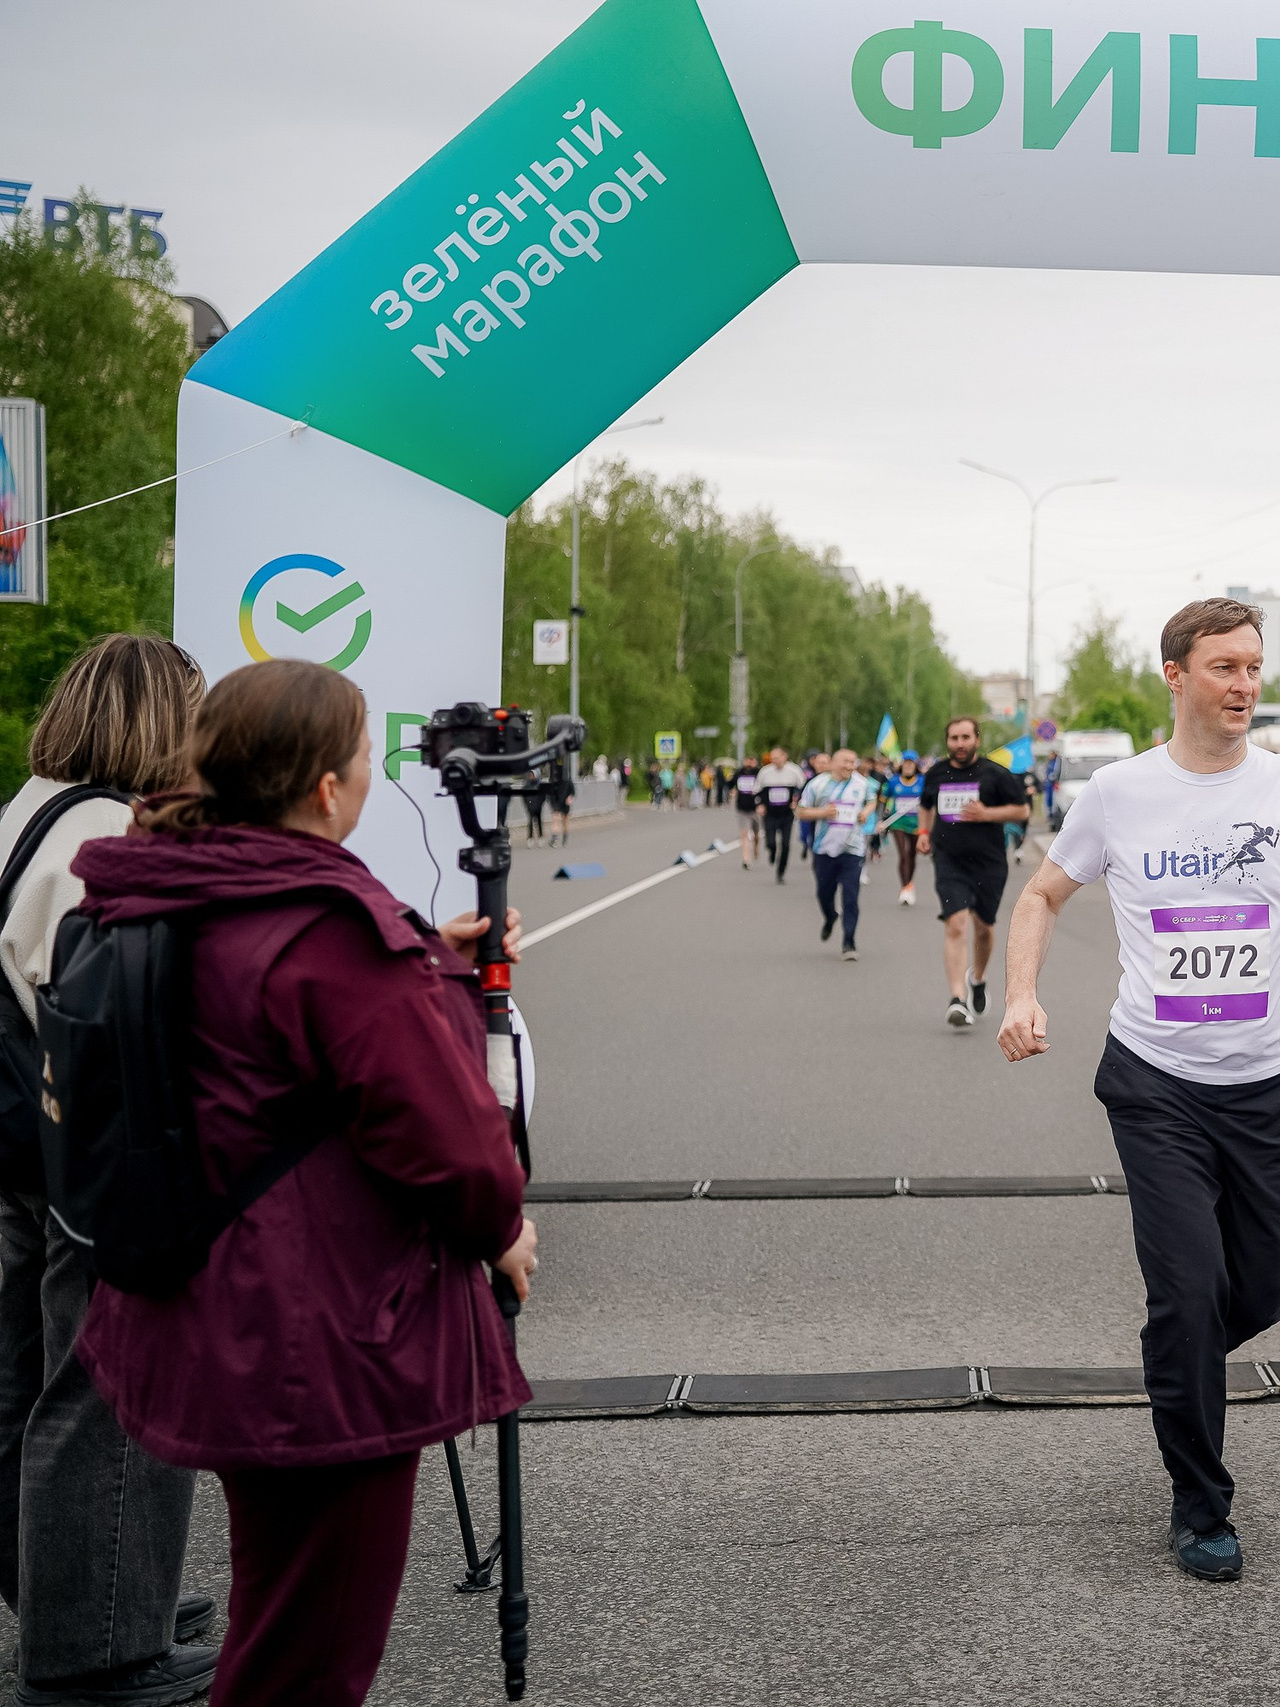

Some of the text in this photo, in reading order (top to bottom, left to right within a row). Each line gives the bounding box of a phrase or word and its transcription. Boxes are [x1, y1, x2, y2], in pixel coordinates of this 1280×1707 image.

[44, 199, 167, 260] ВТБ
[369, 98, 624, 330] зелёный
[410, 150, 667, 379] марафон
[1144, 846, 1224, 880] Utair
[1169, 944, 1258, 980] 2072
